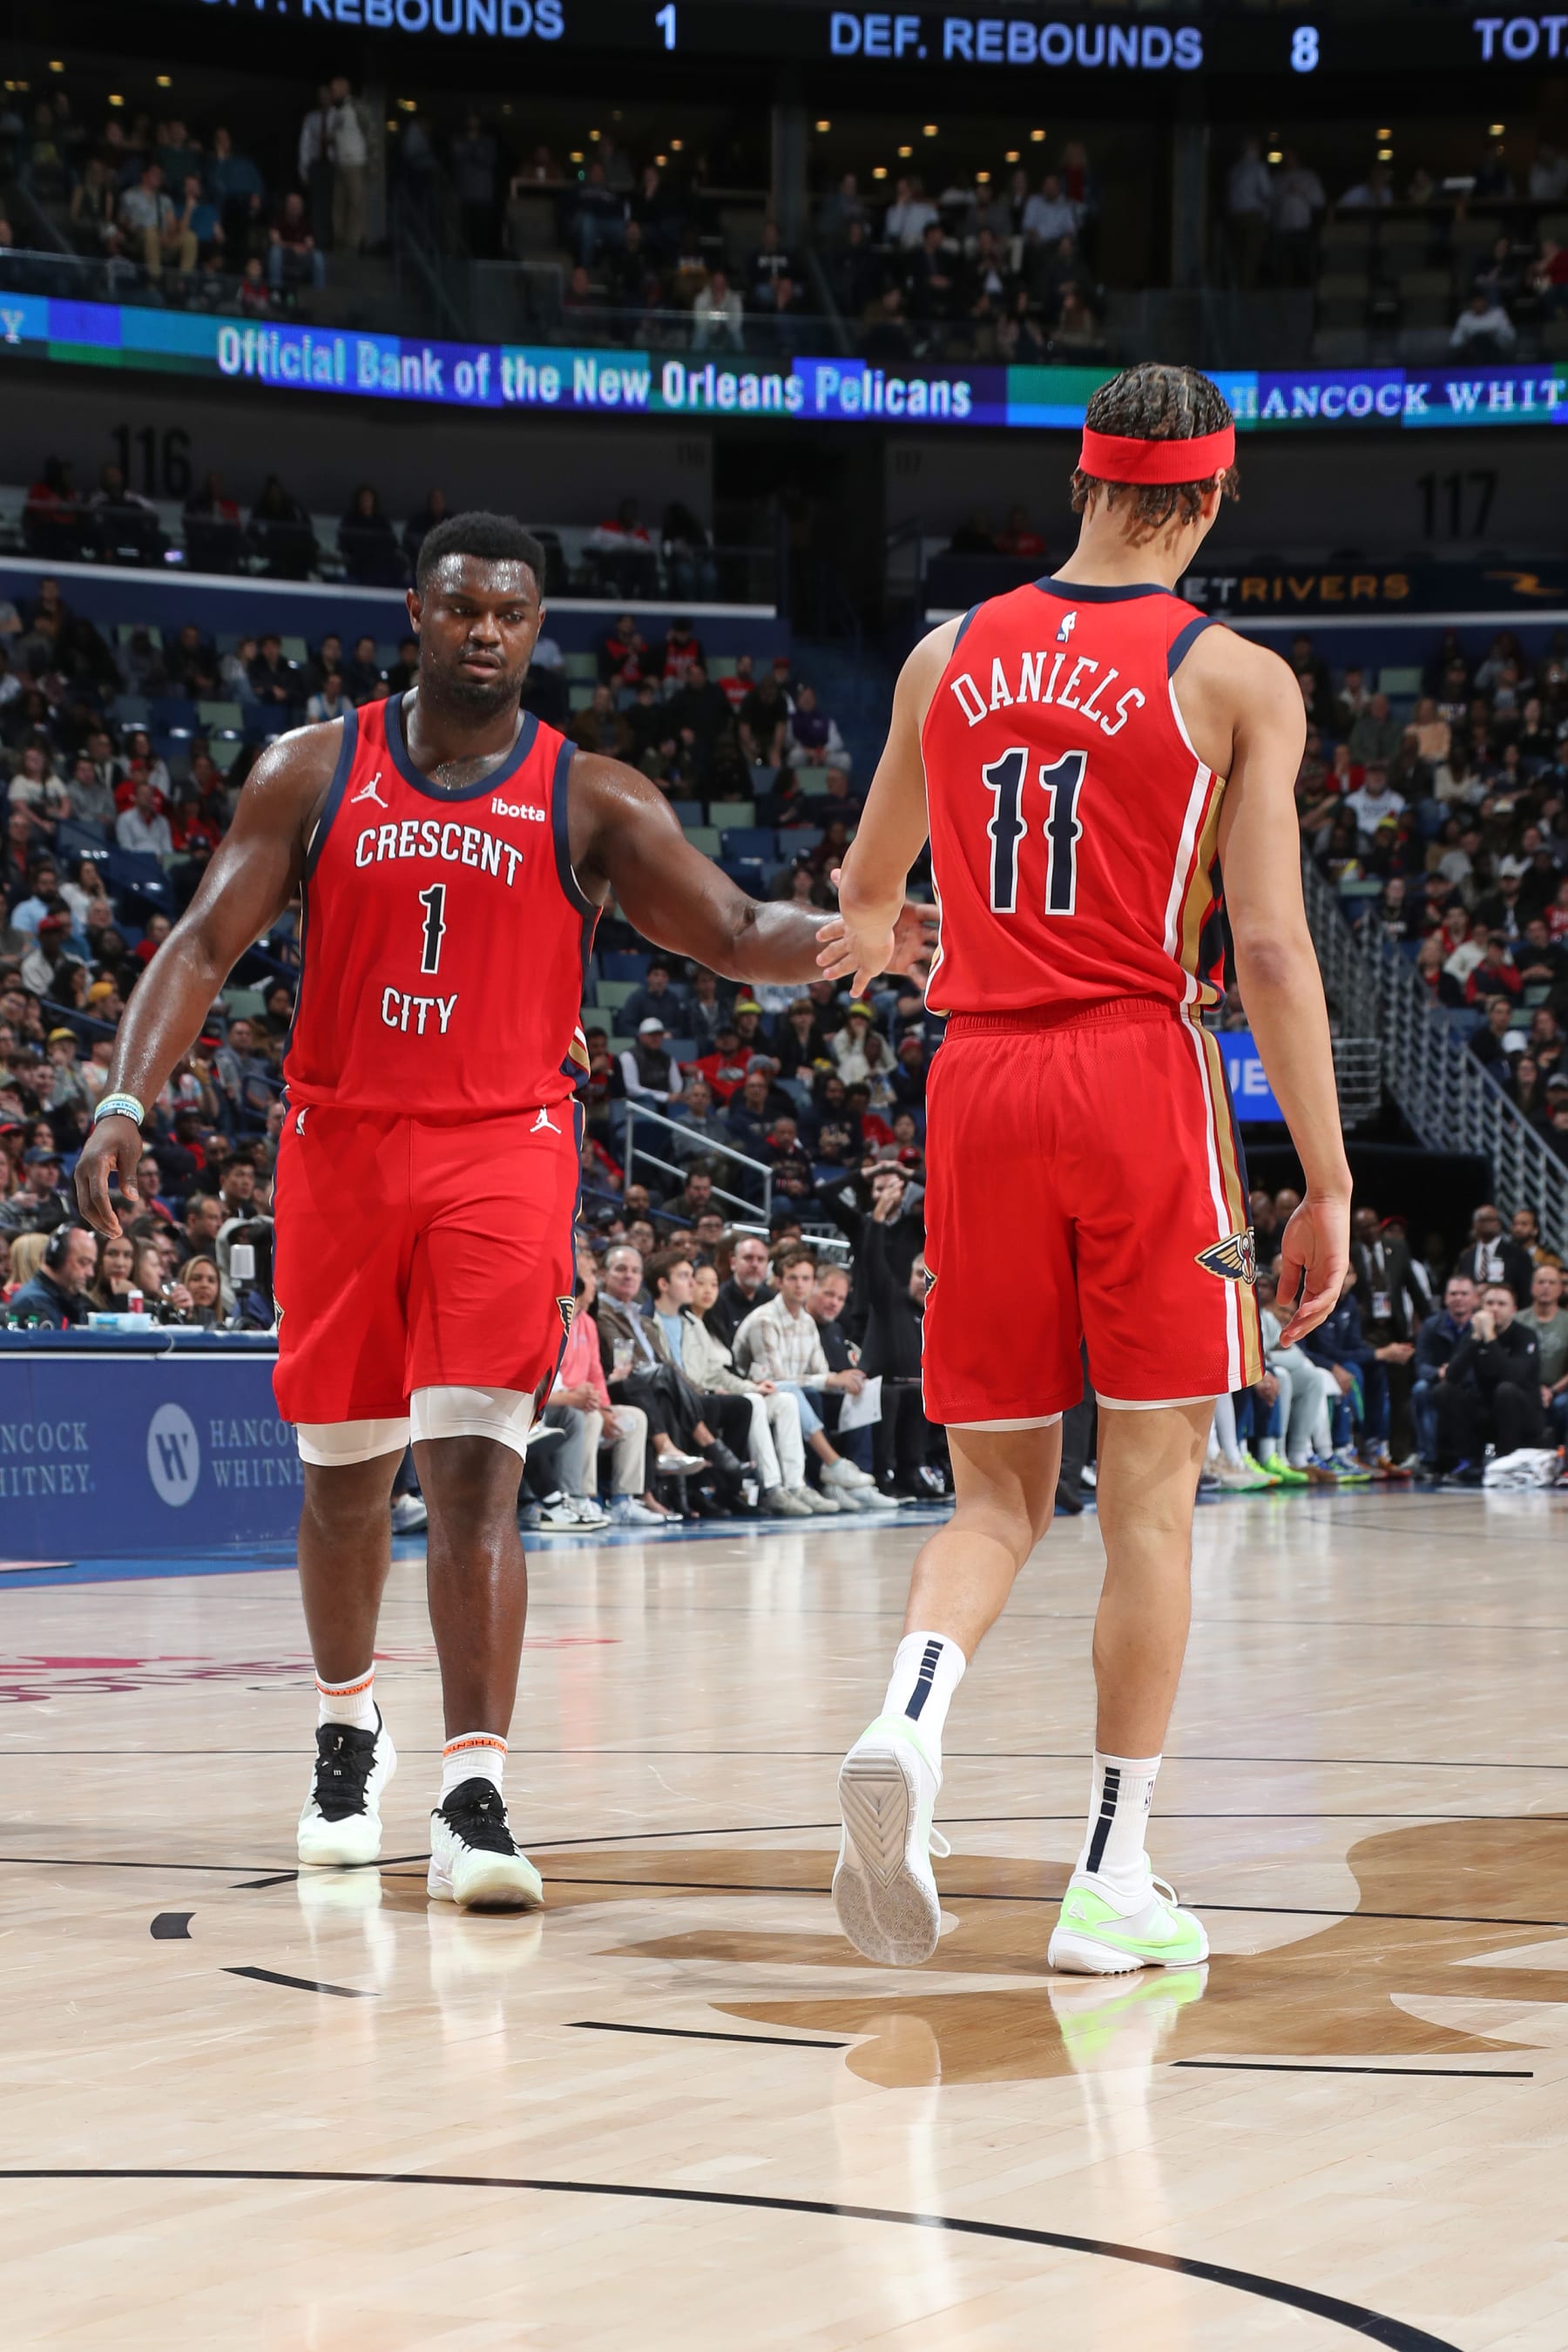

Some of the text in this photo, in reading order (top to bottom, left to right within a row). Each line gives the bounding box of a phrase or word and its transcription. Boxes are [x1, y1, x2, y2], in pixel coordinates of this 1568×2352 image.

[654, 4, 676, 50] 1
[830, 13, 1204, 70] DEF. REBOUNDS
[1291, 26, 1320, 72] 8
[1472, 14, 1568, 63] TOT
[217, 324, 971, 418] Official Bank of the New Orleans Pelicans
[1232, 379, 1567, 419] HANCOCK WHIT
[111, 422, 191, 500] 116
[1416, 468, 1499, 539] 117
[1182, 572, 1409, 603] ETRIVERS
[950, 651, 1146, 735] DANIELS
[490, 797, 546, 822] ibotta
[982, 747, 1088, 916] 11
[355, 819, 524, 888] CRESCENT
[417, 882, 448, 975] 1
[381, 986, 459, 1036] CITY
